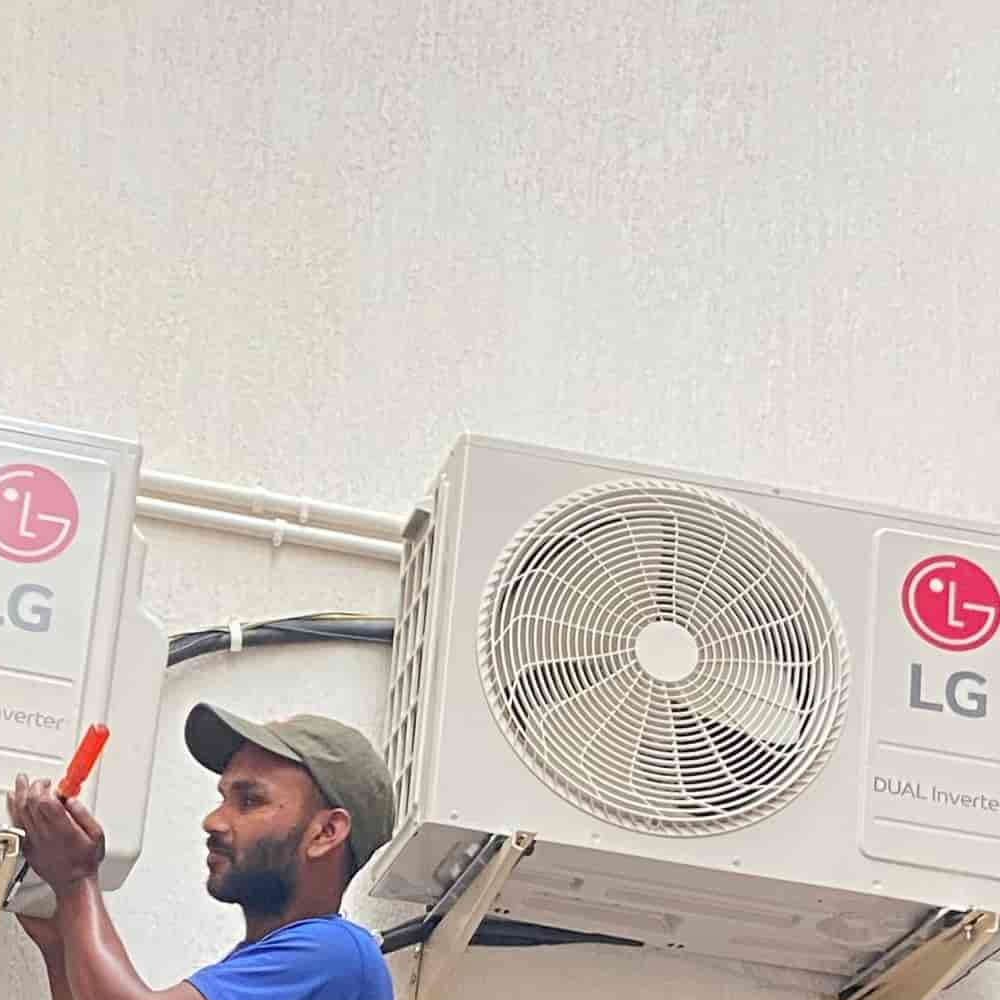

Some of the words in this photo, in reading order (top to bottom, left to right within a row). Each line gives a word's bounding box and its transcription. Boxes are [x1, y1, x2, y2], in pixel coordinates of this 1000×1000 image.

[910, 663, 987, 719] LG
[873, 776, 929, 800] DUAL
[931, 785, 1000, 812] Inverte
